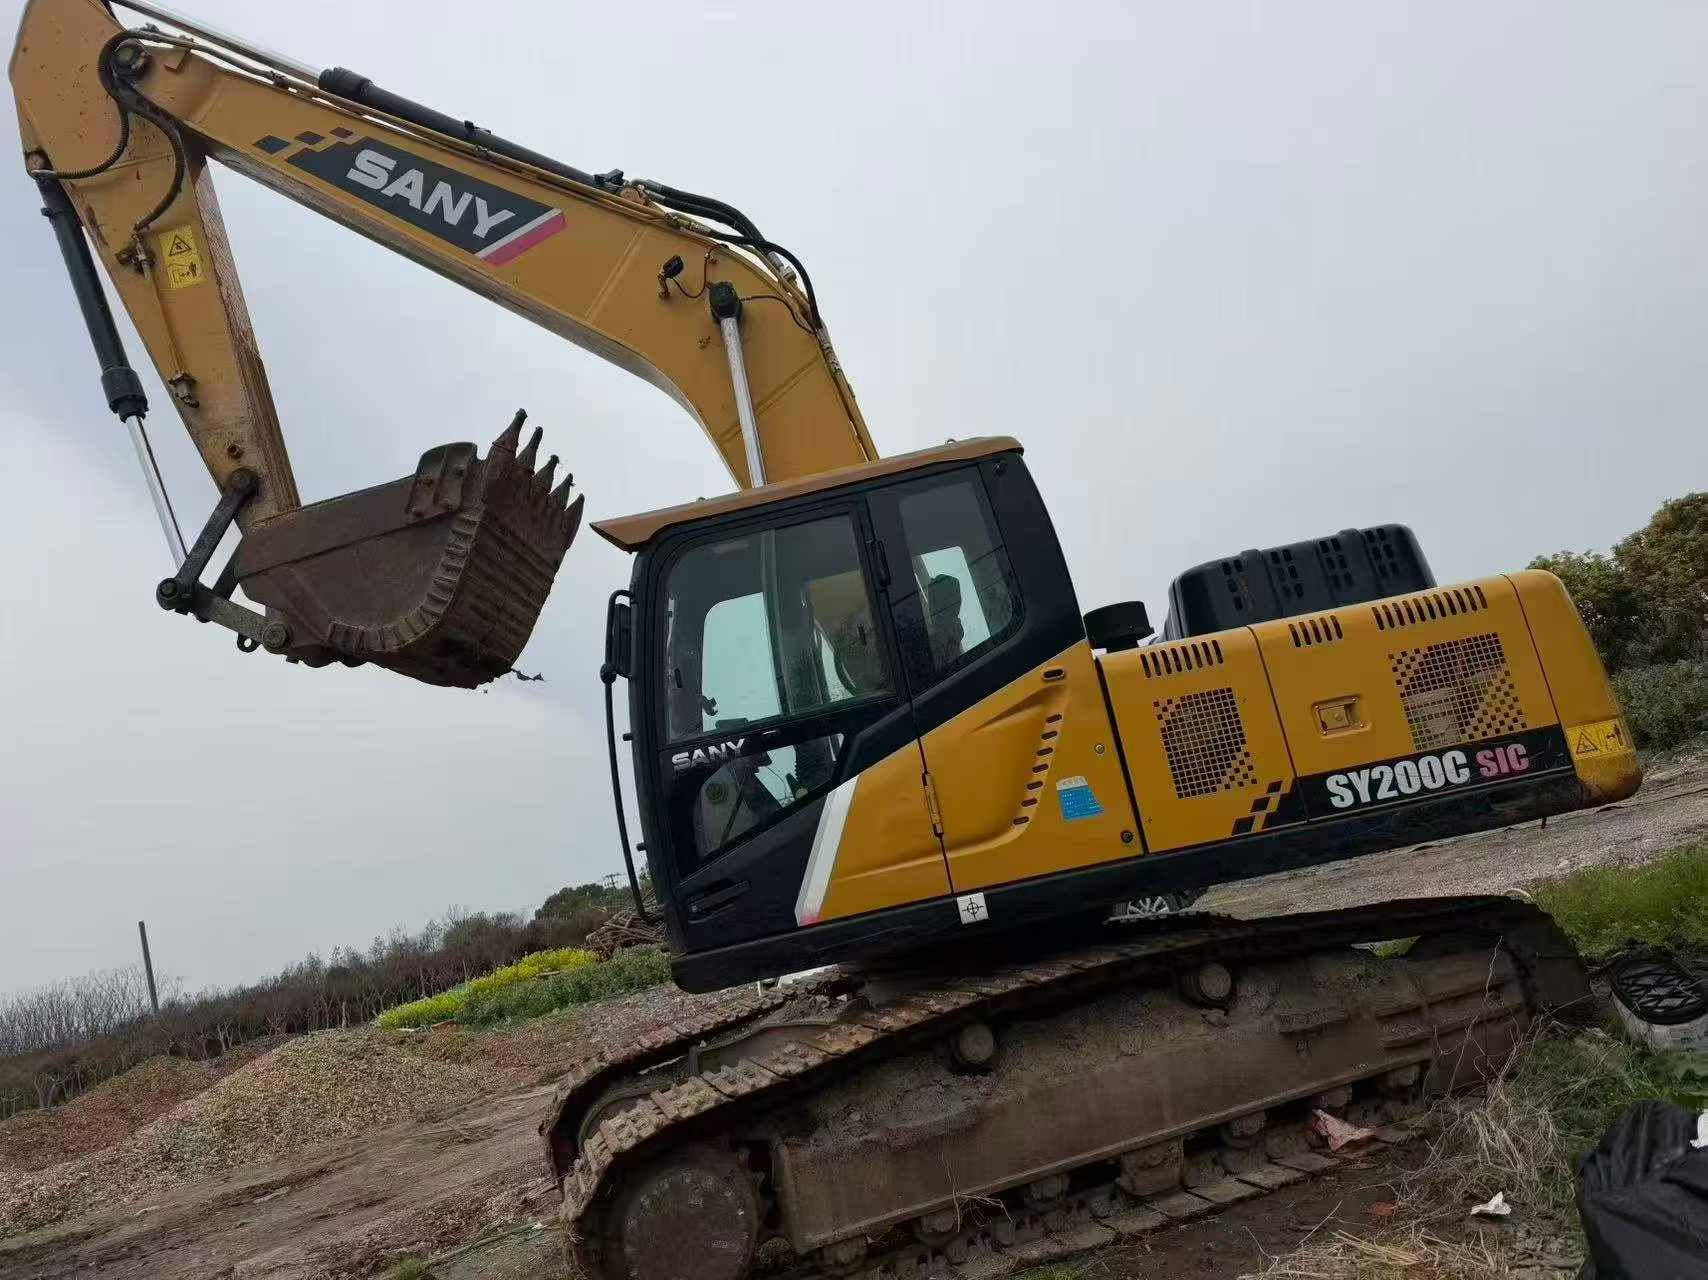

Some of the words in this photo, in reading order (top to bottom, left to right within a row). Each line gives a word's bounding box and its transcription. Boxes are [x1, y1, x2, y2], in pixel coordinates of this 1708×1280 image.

[346, 149, 516, 239] SANY
[671, 738, 746, 770] SANY
[1325, 750, 1471, 808] SY200C
[1475, 743, 1530, 778] SIC
